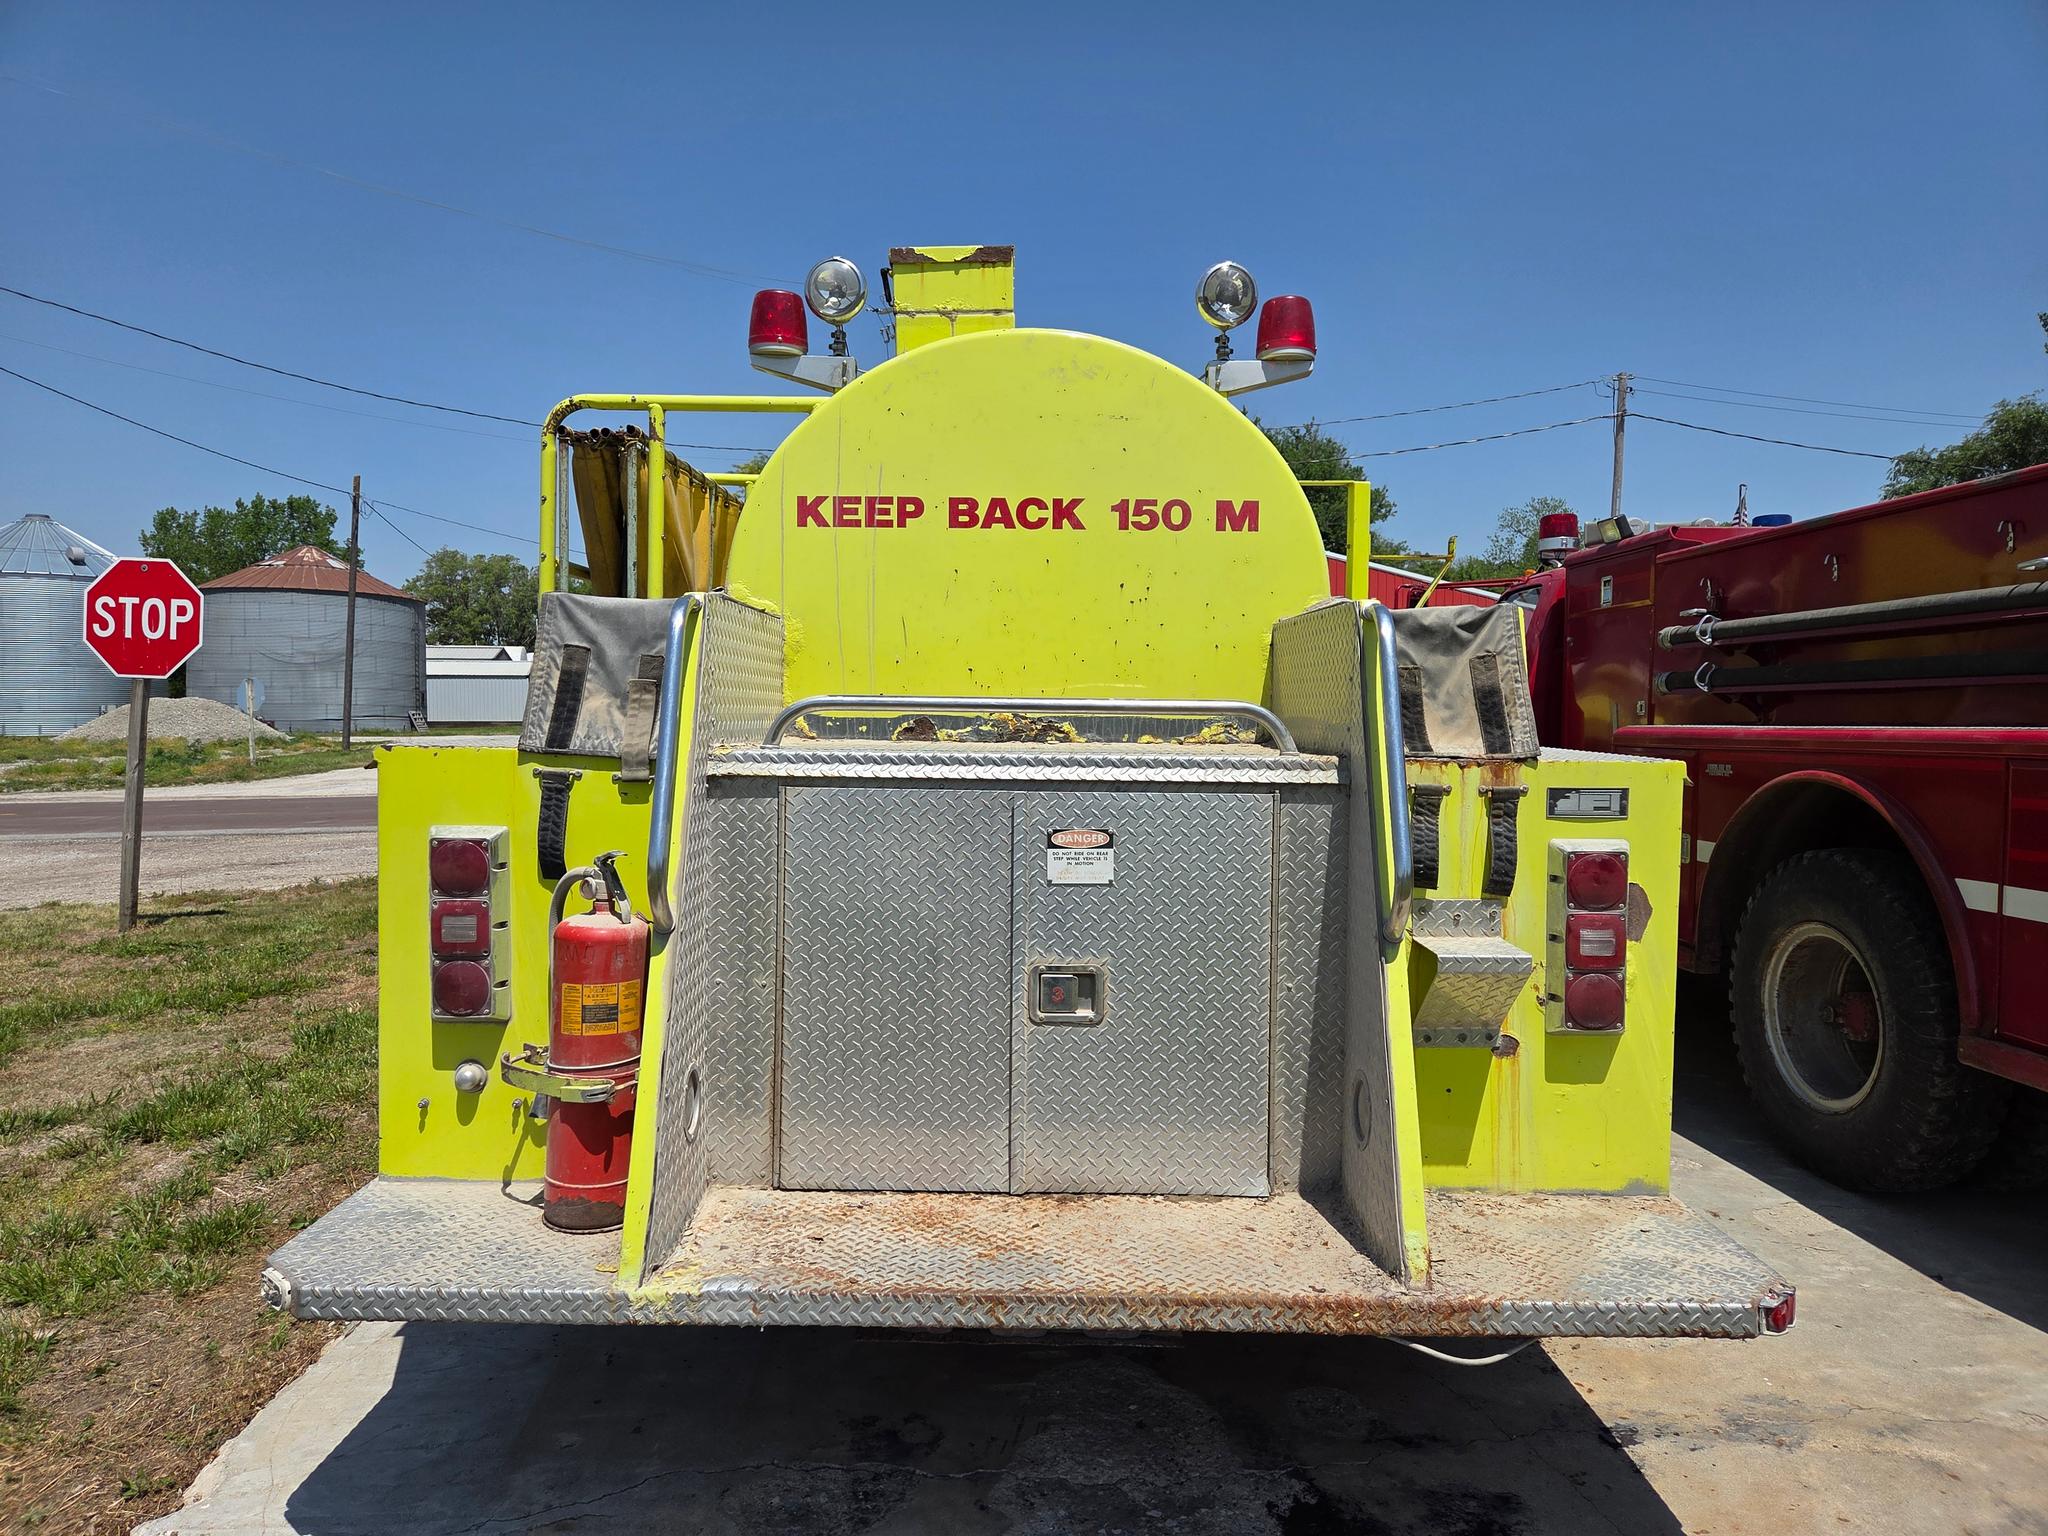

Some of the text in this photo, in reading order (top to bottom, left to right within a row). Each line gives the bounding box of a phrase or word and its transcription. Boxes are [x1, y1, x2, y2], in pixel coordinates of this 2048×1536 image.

[797, 496, 1260, 532] KEEP BACK 150 M
[92, 596, 194, 640] STOP
[1057, 834, 1104, 843] DANGER
[1052, 986, 1065, 1004] 3
